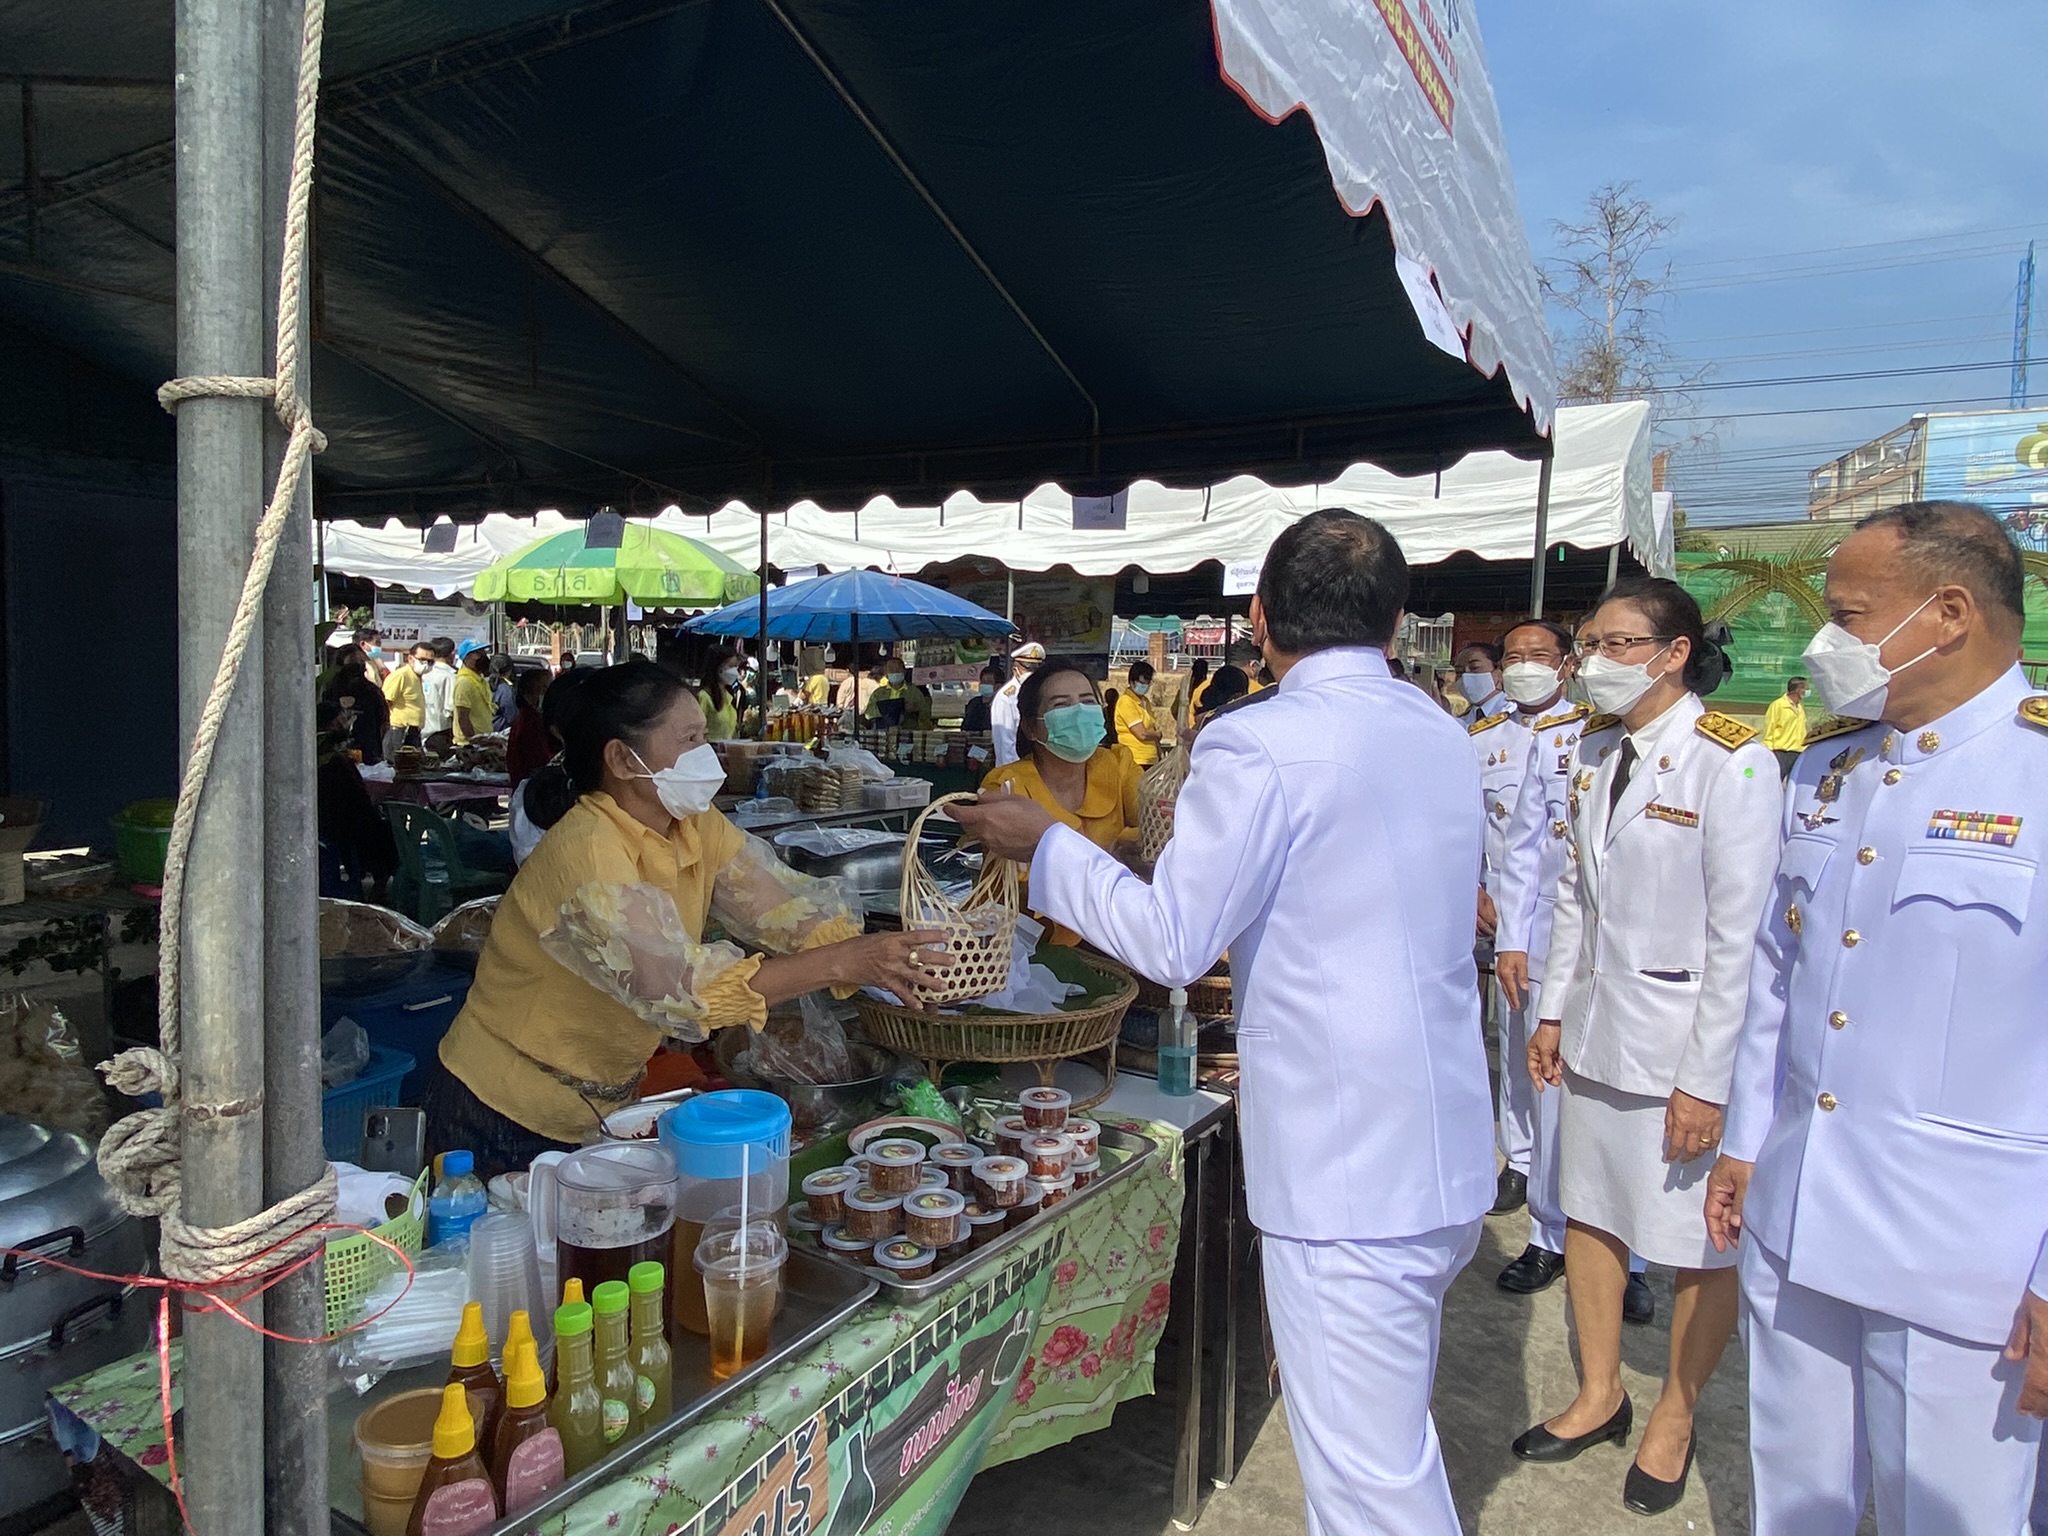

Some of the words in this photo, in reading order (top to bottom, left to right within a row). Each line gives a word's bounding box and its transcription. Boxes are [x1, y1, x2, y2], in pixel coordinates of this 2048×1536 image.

[533, 573, 592, 592] ธ.ก.ส.
[898, 1367, 984, 1479] ขนมไทย
